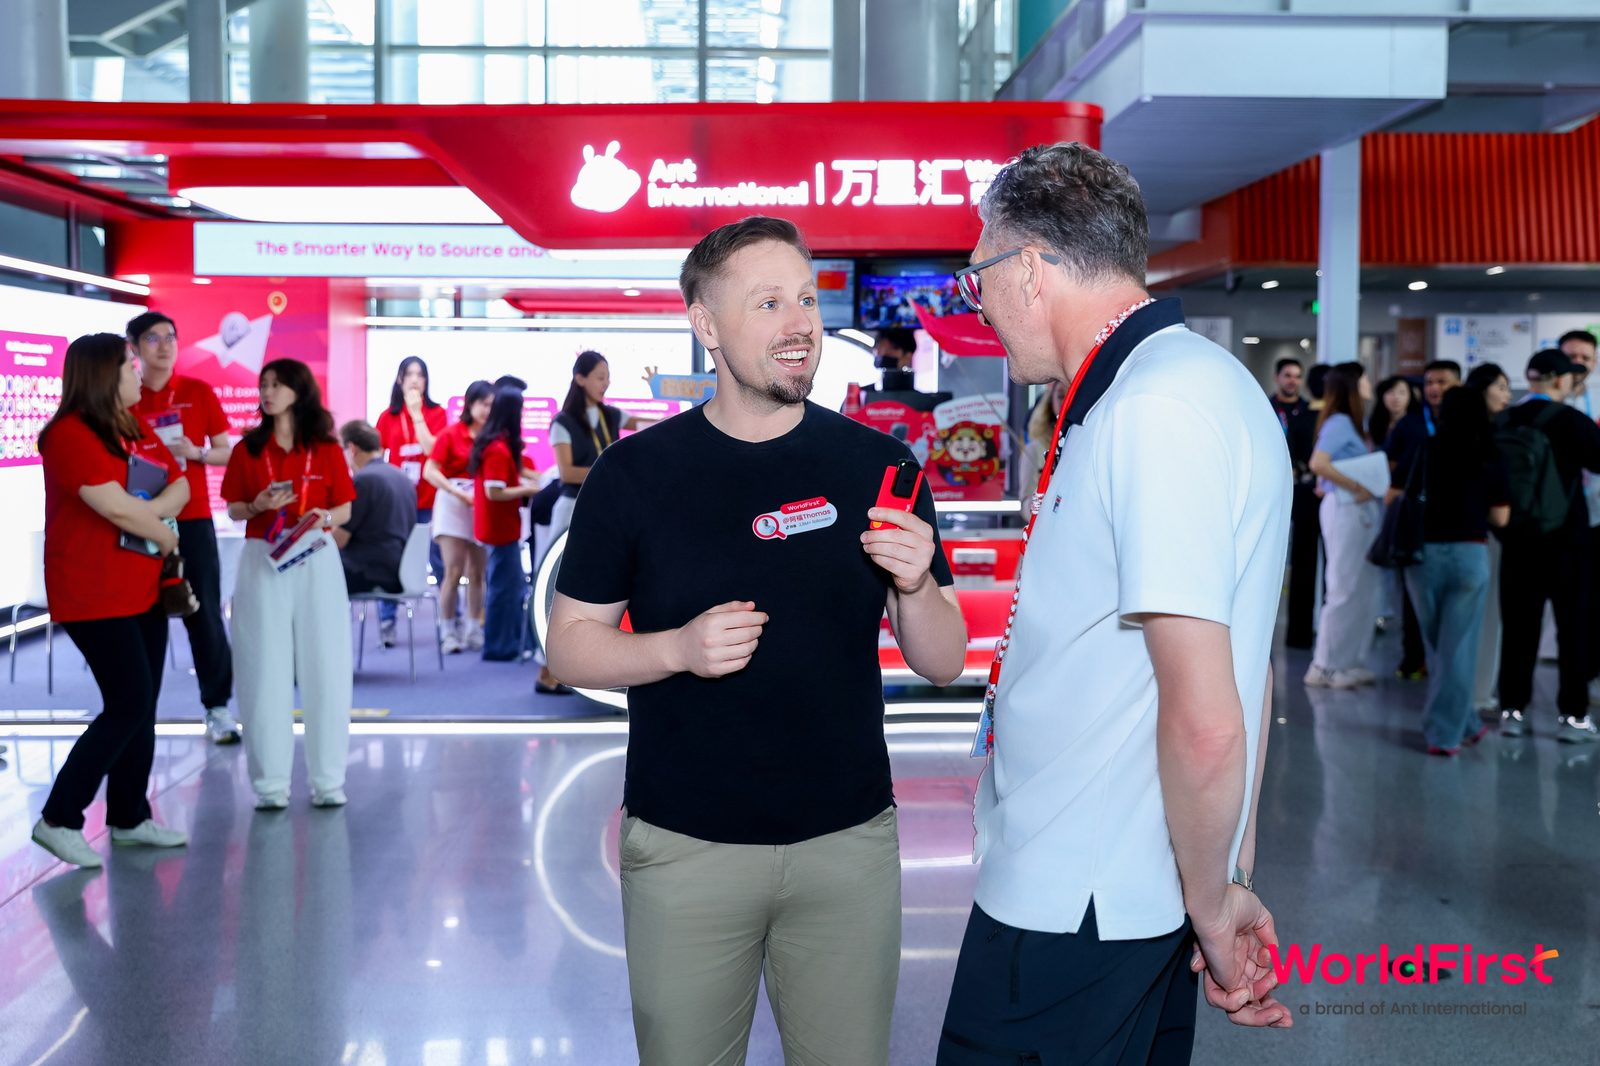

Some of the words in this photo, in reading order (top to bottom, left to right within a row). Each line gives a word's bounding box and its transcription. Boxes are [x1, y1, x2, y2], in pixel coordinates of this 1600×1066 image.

[649, 158, 697, 184] Ant
[647, 181, 809, 208] International
[256, 240, 288, 256] The
[293, 240, 366, 257] Smarter
[372, 241, 413, 260] Way
[418, 242, 436, 257] to
[441, 242, 503, 258] Source
[787, 500, 820, 511] WorldFirst
